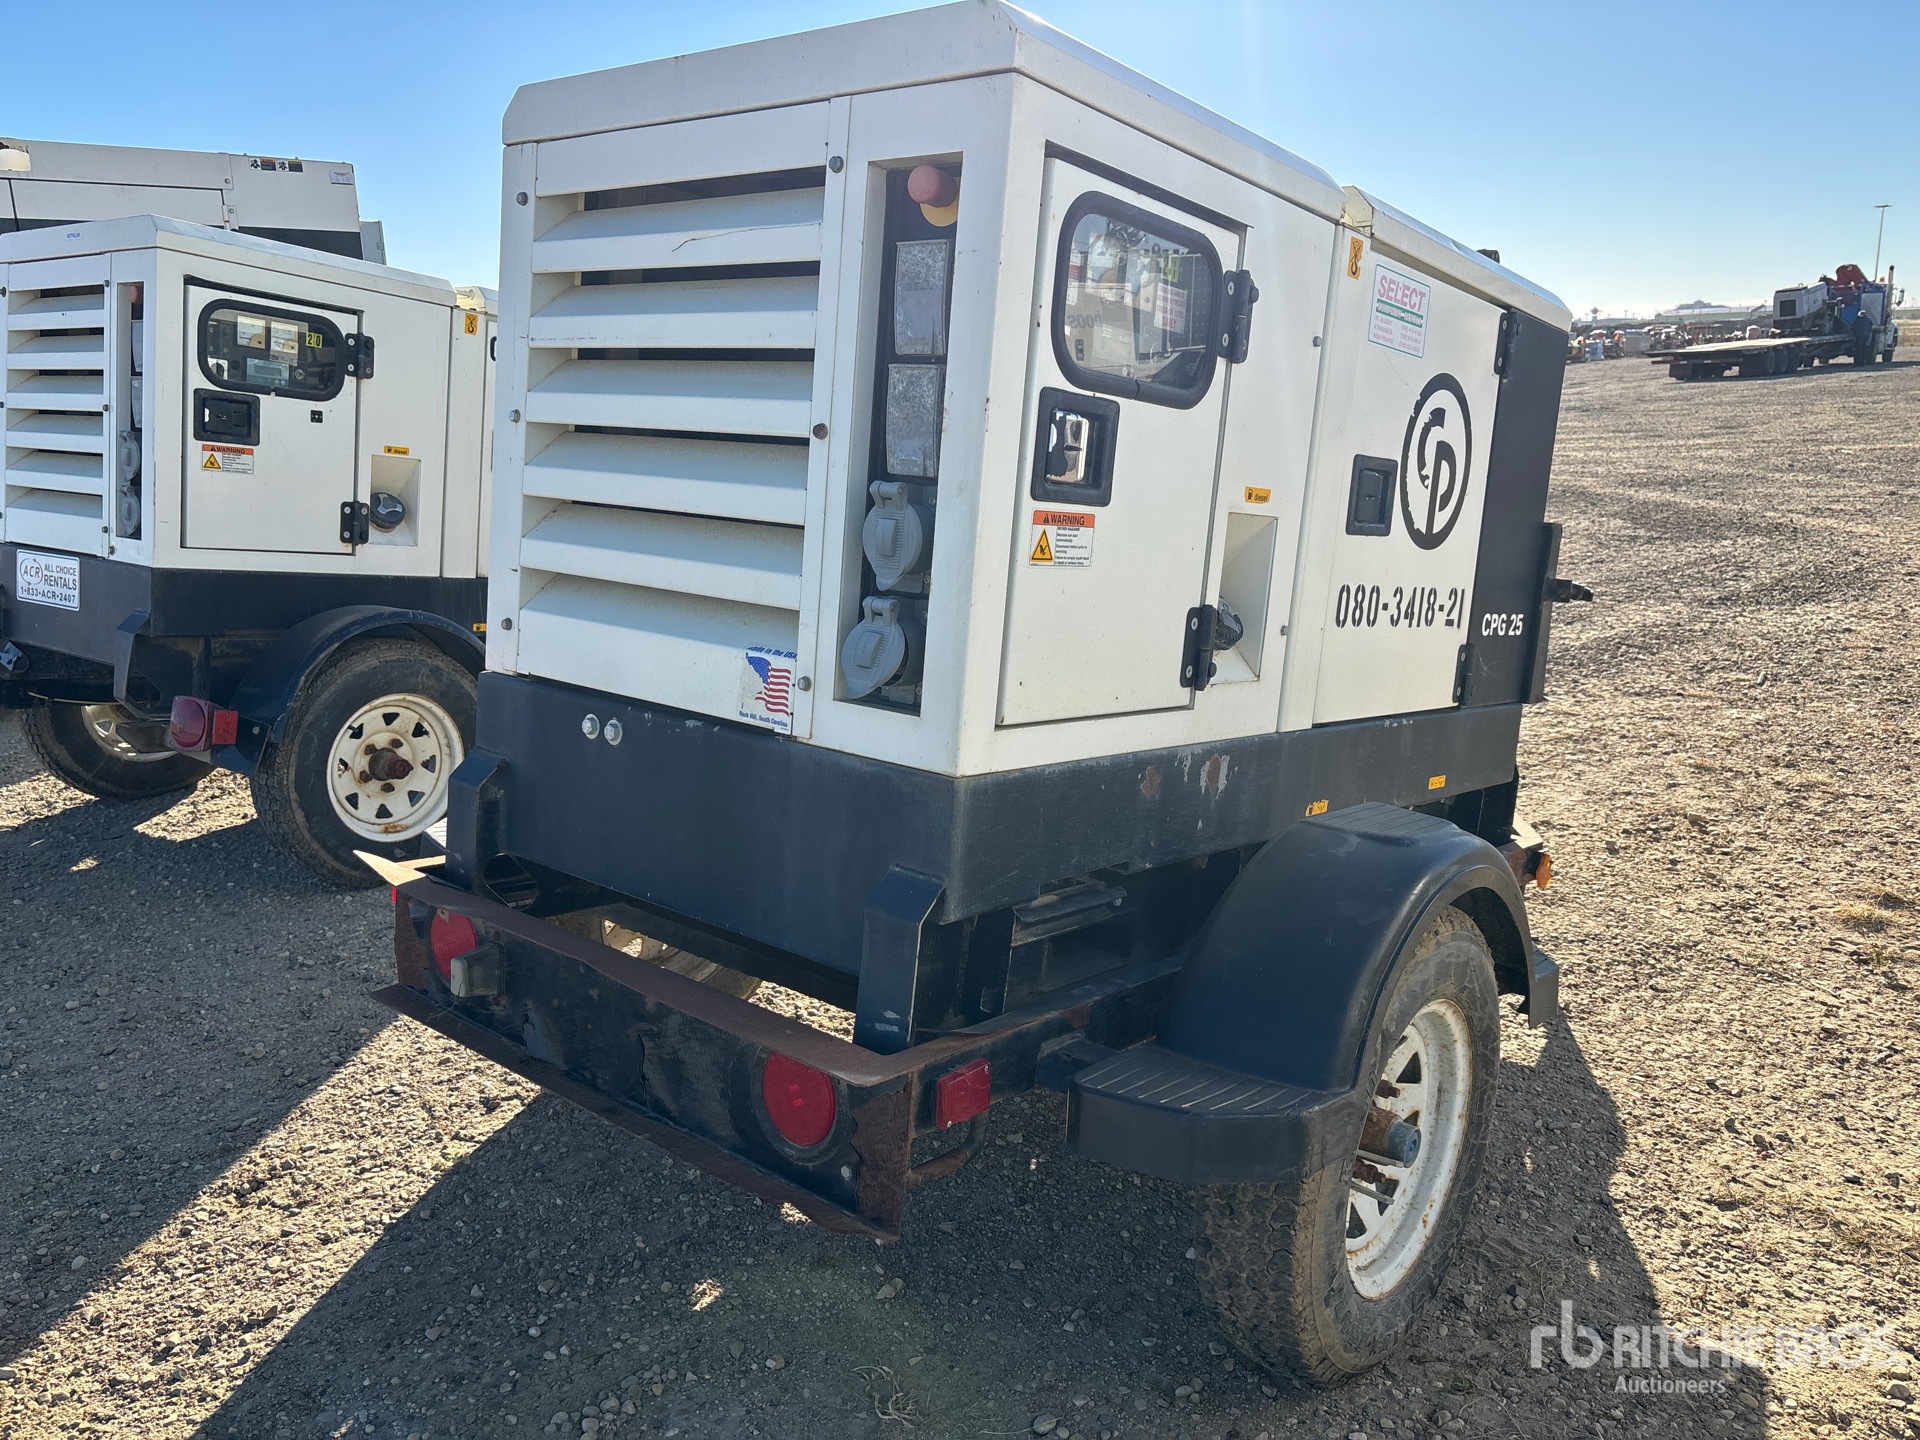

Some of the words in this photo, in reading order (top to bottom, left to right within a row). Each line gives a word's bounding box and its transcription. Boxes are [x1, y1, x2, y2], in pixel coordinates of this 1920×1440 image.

[1378, 275, 1426, 312] SELECT
[307, 333, 321, 347] 20
[1050, 514, 1085, 526] WARNING
[23, 565, 40, 578] ACR
[44, 563, 55, 573] ALL
[56, 565, 77, 577] CHOICE
[44, 574, 77, 591] RENTALS
[1335, 583, 1465, 629] 080-3418-21
[1481, 613, 1507, 636] CPG
[1508, 613, 1524, 636] 25
[784, 651, 797, 659] USA
[759, 715, 770, 723] South
[771, 718, 788, 727] Carolina
